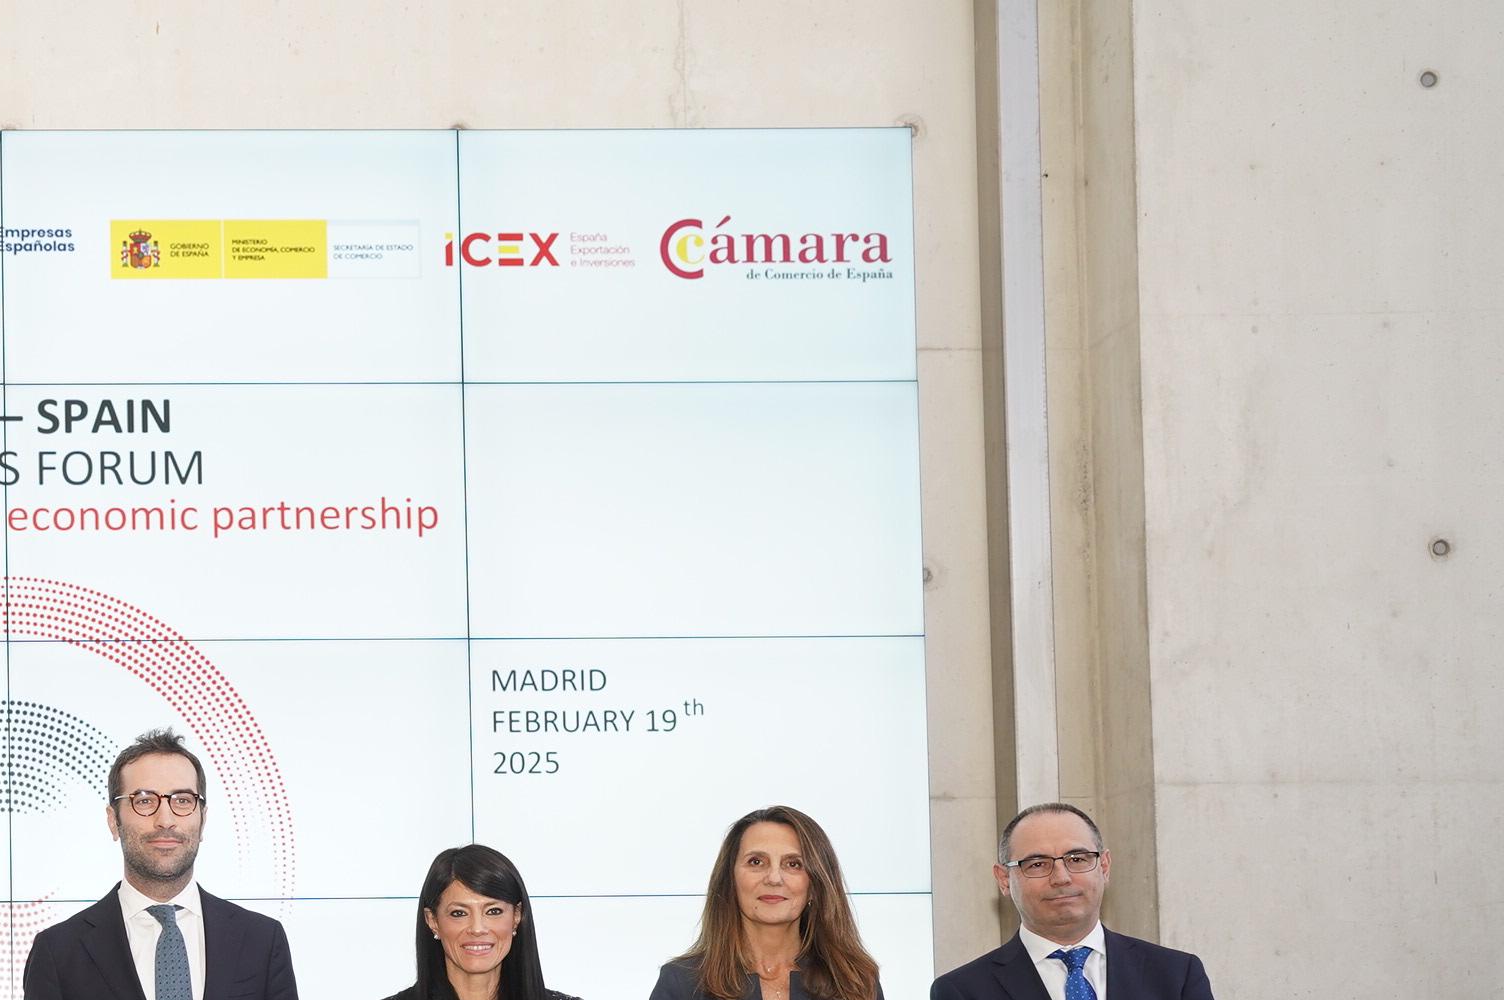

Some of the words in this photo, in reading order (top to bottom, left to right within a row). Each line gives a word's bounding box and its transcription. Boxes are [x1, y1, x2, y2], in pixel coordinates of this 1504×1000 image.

[170, 242, 210, 250] GOBIERNO
[570, 231, 609, 244] España
[660, 215, 894, 280] Cámara
[181, 249, 210, 257] ESPAÑA
[570, 244, 631, 257] Exportación
[579, 257, 637, 268] Inversiones
[746, 268, 762, 280] de
[764, 267, 824, 280] Comercio
[827, 267, 843, 280] de
[846, 266, 894, 283] España
[36, 398, 172, 435] SPAIN
[37, 450, 204, 486] FORUM
[7, 498, 199, 532] economic
[212, 496, 439, 539] partnership
[491, 668, 608, 692] MADRID
[492, 709, 636, 733] FEBRUARY
[493, 751, 560, 774] 2025
